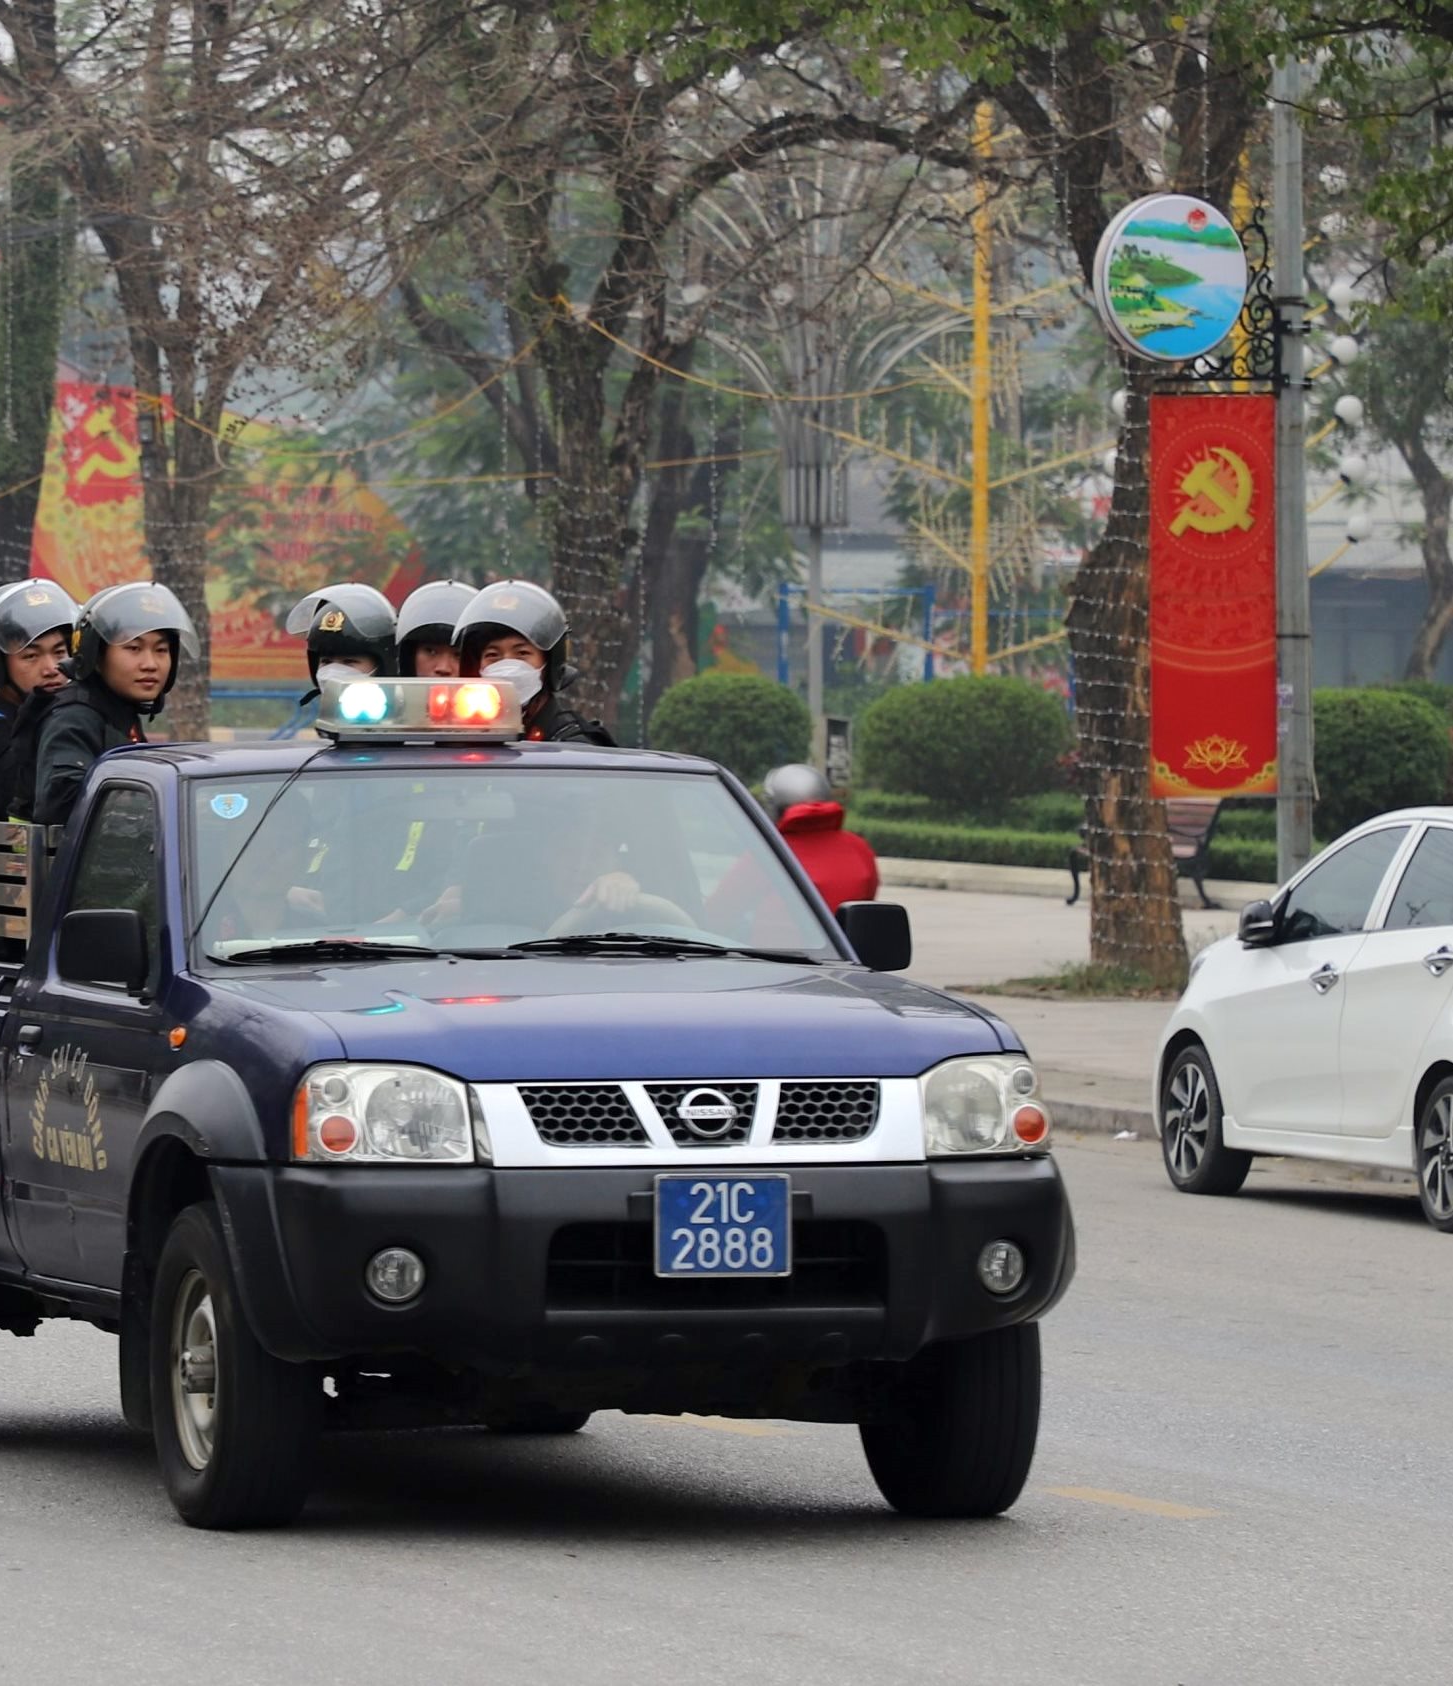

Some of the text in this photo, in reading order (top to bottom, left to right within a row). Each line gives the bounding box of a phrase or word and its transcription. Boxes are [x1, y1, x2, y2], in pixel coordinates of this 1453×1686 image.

[685, 1107, 735, 1116] NISSAN
[689, 1181, 756, 1225] 21C
[670, 1226, 775, 1270] 2888
